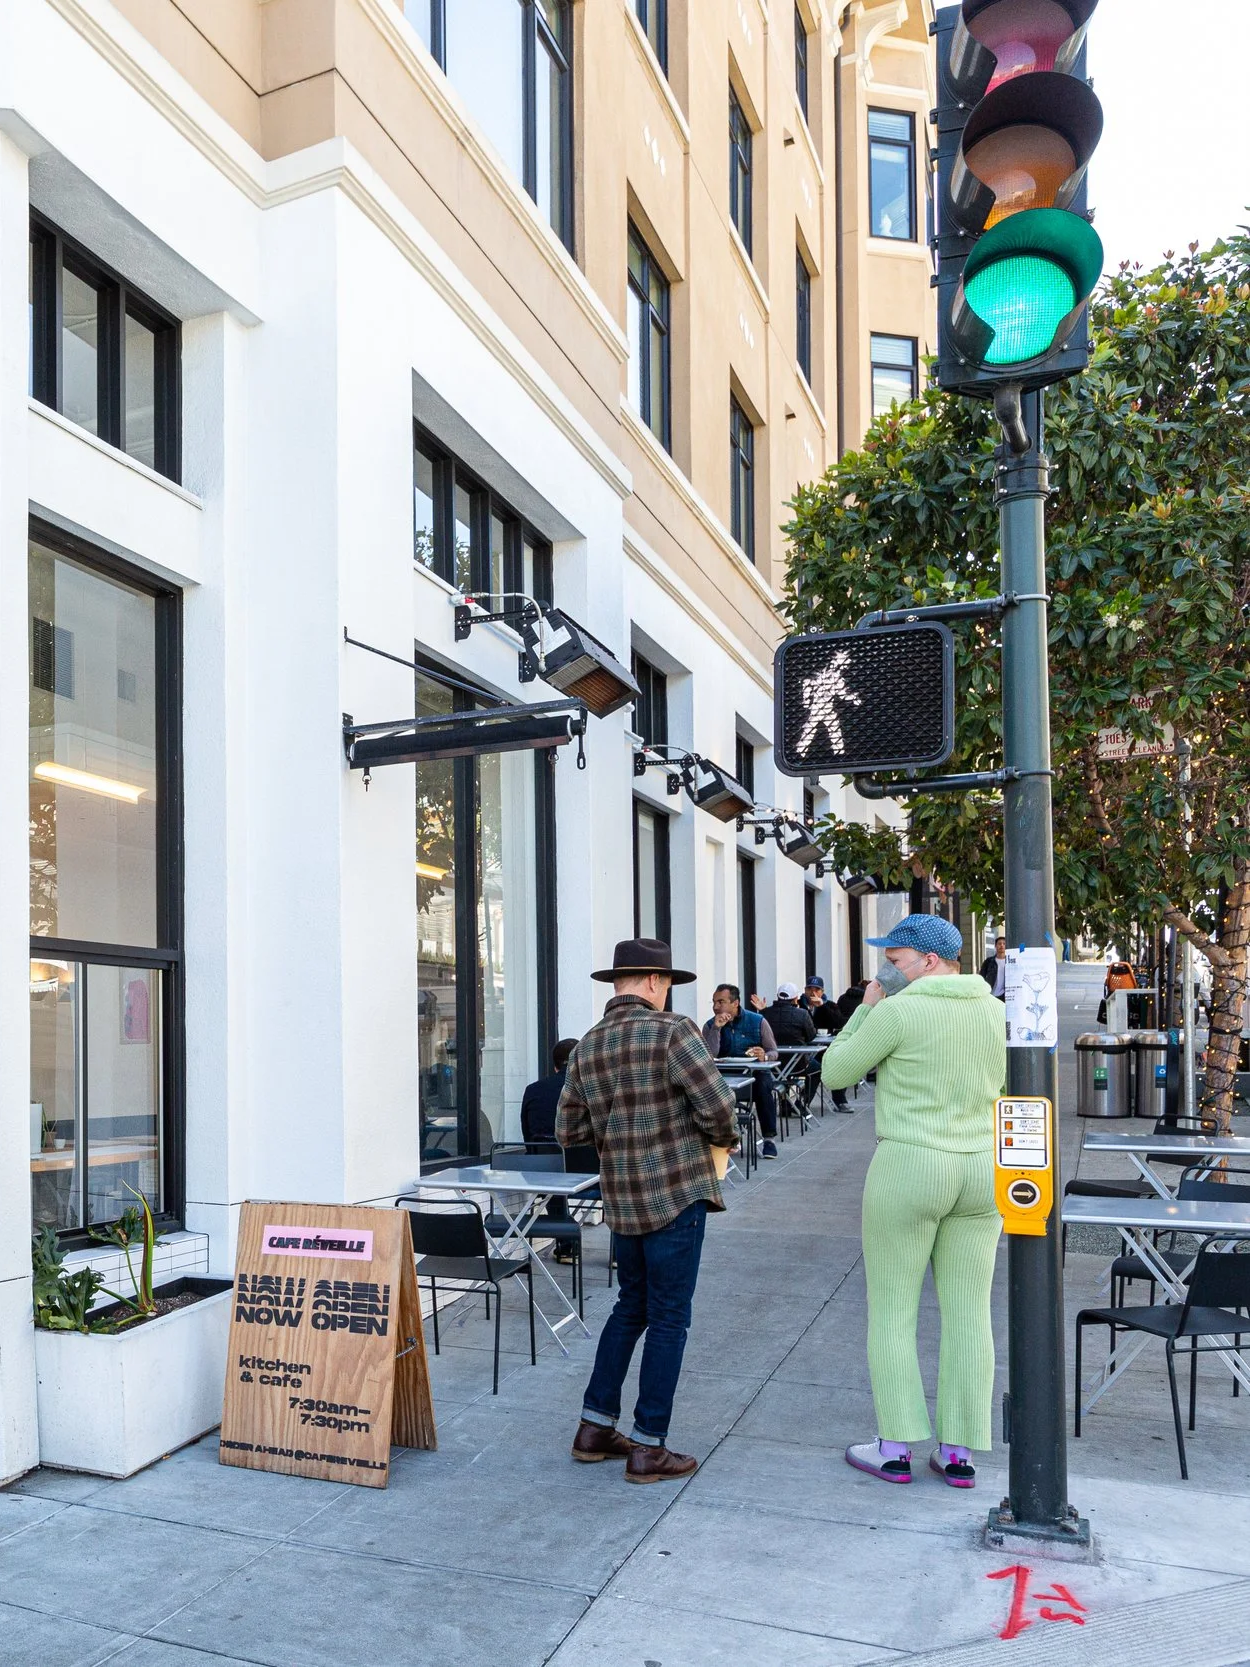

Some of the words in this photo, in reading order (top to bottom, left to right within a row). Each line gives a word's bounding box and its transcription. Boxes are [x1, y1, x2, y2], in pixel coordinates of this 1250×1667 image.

[268, 1236, 301, 1249] CAFE
[302, 1235, 365, 1253] RÉVEILLE
[235, 1305, 303, 1328] NOW
[311, 1312, 389, 1336] OPEN
[239, 1355, 311, 1375] kitchen
[240, 1371, 253, 1383] &
[259, 1374, 302, 1388] cafe
[301, 1413, 370, 1433] 7:30pm
[255, 1444, 293, 1457] AHEAD
